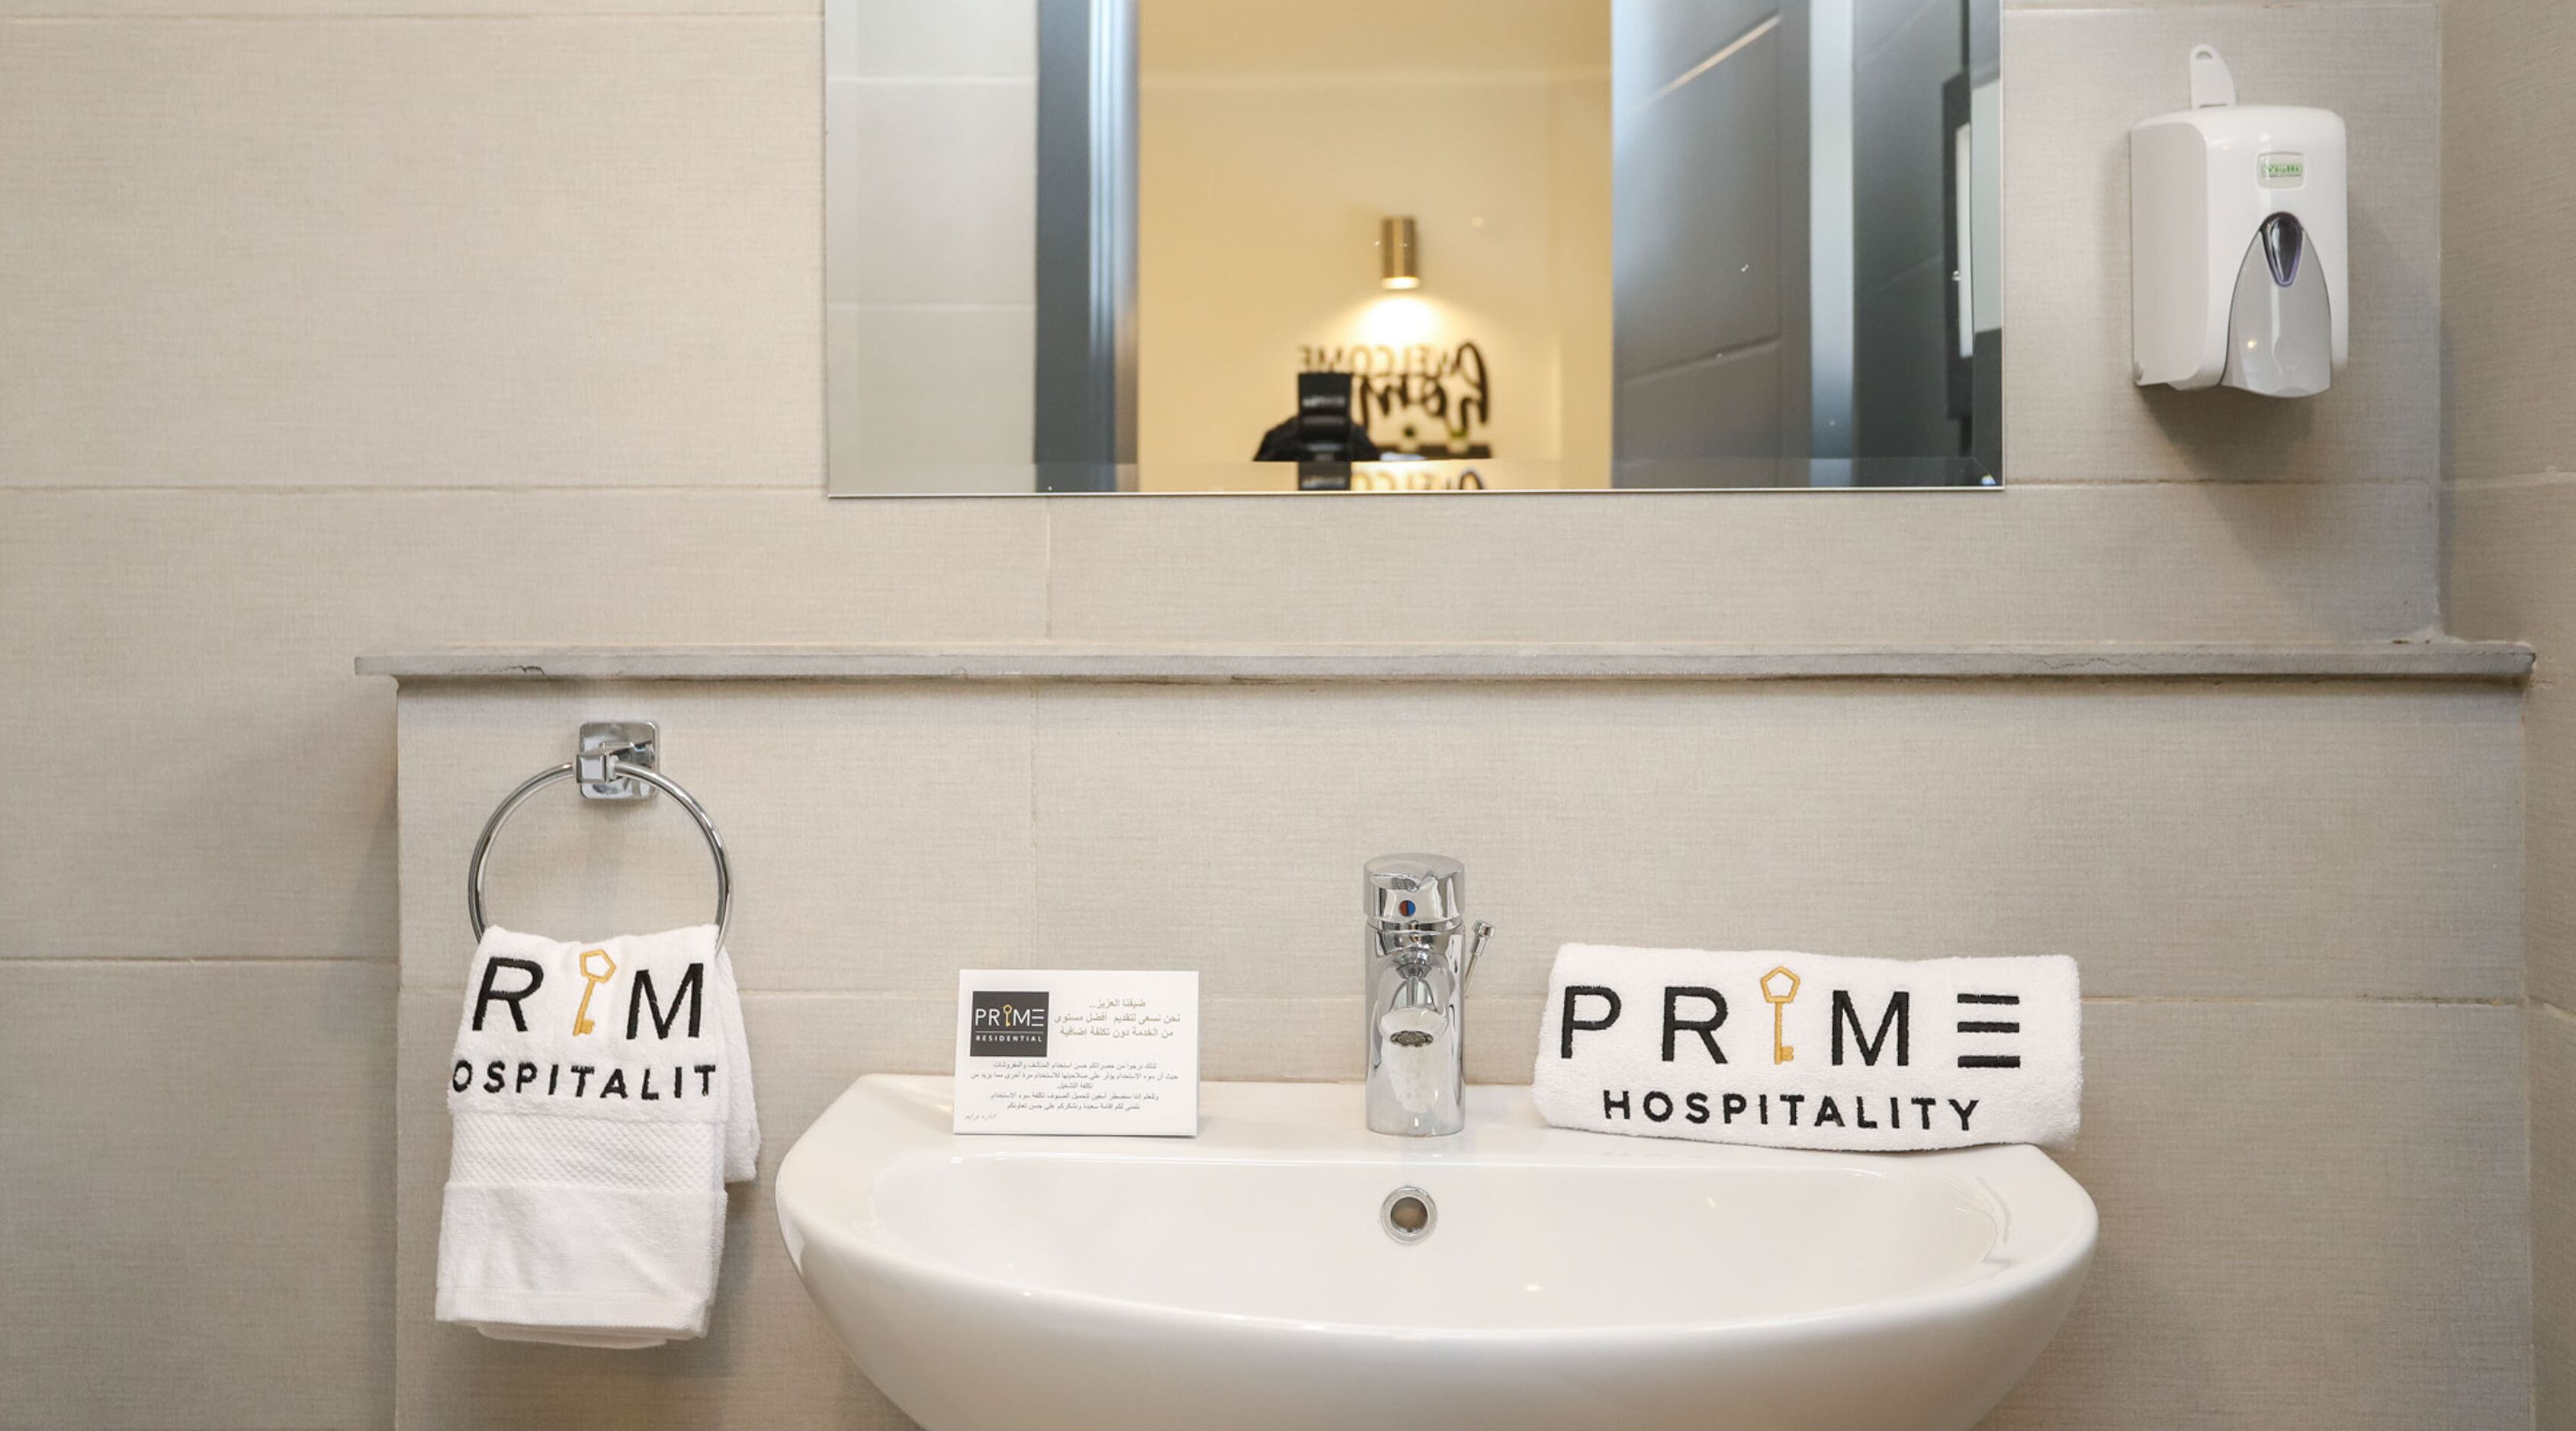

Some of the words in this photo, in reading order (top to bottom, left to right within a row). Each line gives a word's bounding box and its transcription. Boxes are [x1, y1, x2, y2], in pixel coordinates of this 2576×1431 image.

[975, 1003, 1045, 1028] PRIME
[1164, 1013, 1180, 1024] نحن
[1560, 966, 2021, 1069] PRIME
[1112, 1029, 1130, 1038] دون
[1161, 1029, 1174, 1038] من
[1602, 1089, 1980, 1132] HOSPITALITY
